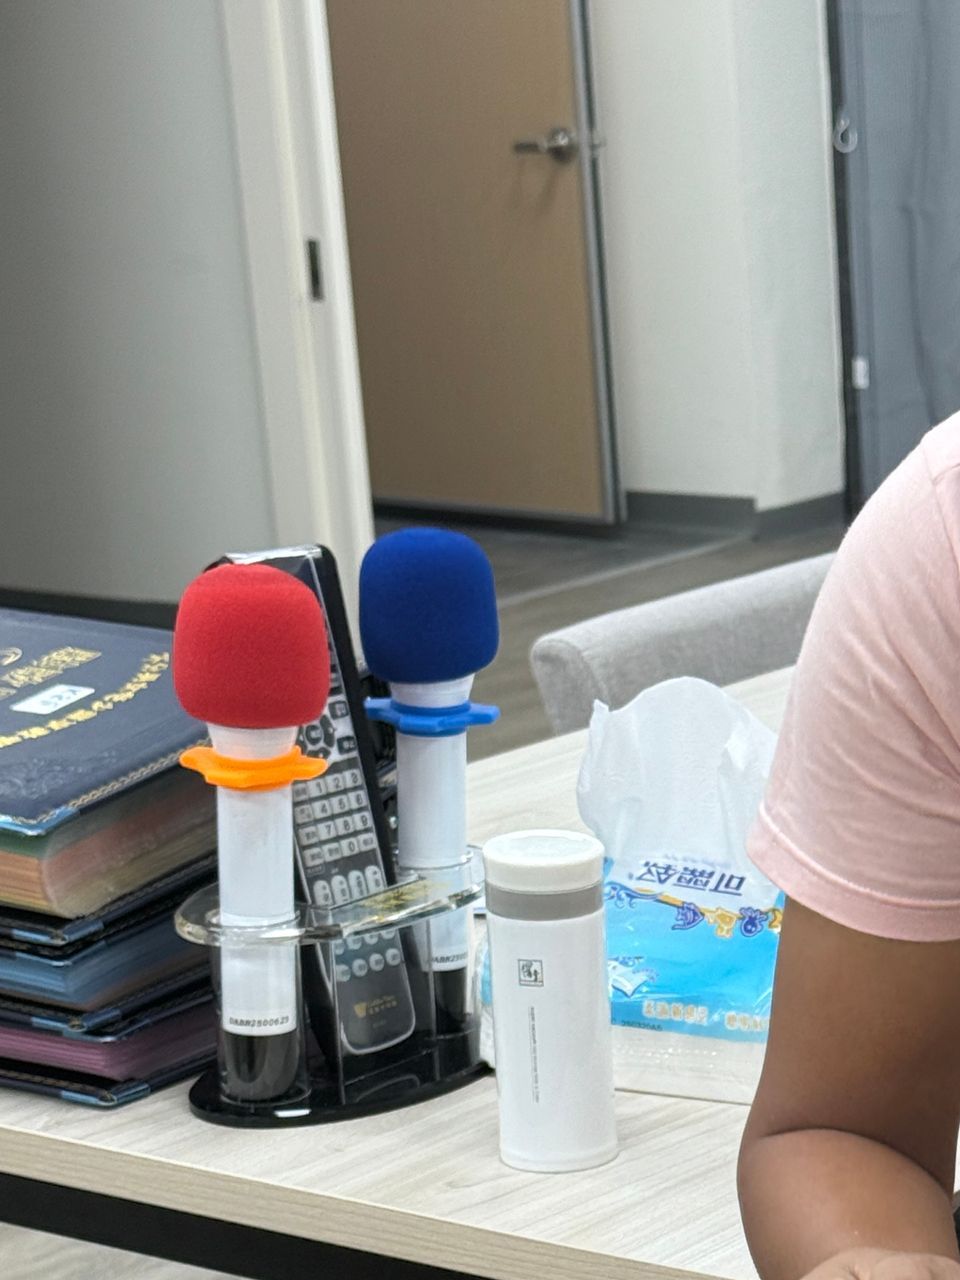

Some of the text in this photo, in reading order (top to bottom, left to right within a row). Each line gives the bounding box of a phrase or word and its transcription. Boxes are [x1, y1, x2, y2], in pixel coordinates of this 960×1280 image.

[315, 782, 323, 793] 1
[334, 777, 341, 789] 2
[321, 803, 328, 814] 4
[338, 798, 346, 810] 5
[356, 793, 363, 805] 6
[325, 824, 332, 836] 7
[343, 819, 351, 831] 8
[360, 815, 368, 826] 9
[348, 840, 356, 852] 0
[635, 861, 746, 897] 可麗舒
